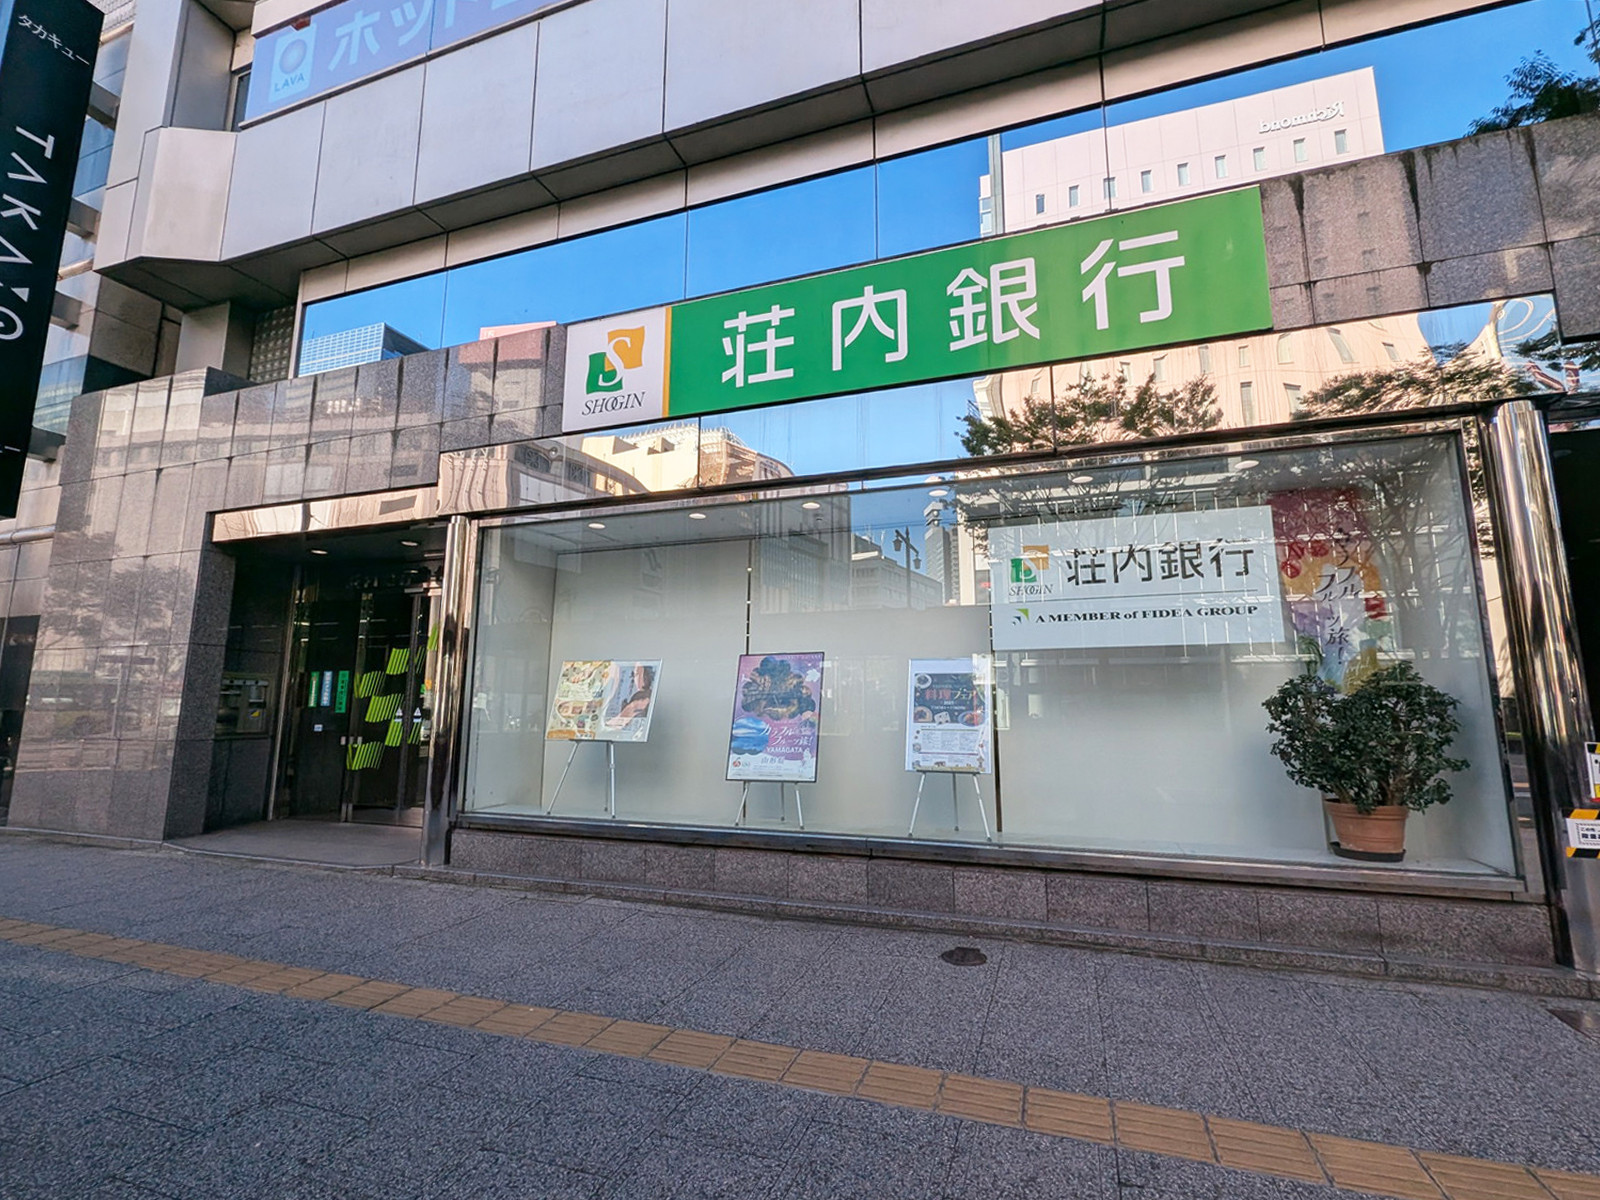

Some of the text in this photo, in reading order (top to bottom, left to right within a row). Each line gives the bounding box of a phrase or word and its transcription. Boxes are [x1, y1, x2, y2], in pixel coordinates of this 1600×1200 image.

[18, 14, 90, 66] タカキュー
[274, 73, 305, 93] LAVA
[721, 230, 1186, 388] 荘内銀行
[581, 391, 646, 416] SHOGIN
[1066, 538, 1254, 586] 荘内銀行
[1009, 584, 1054, 597] SHOGIN
[1036, 605, 1258, 623] A MEMBER of FIDEA GROUP
[766, 746, 803, 754] YAMAGATA
